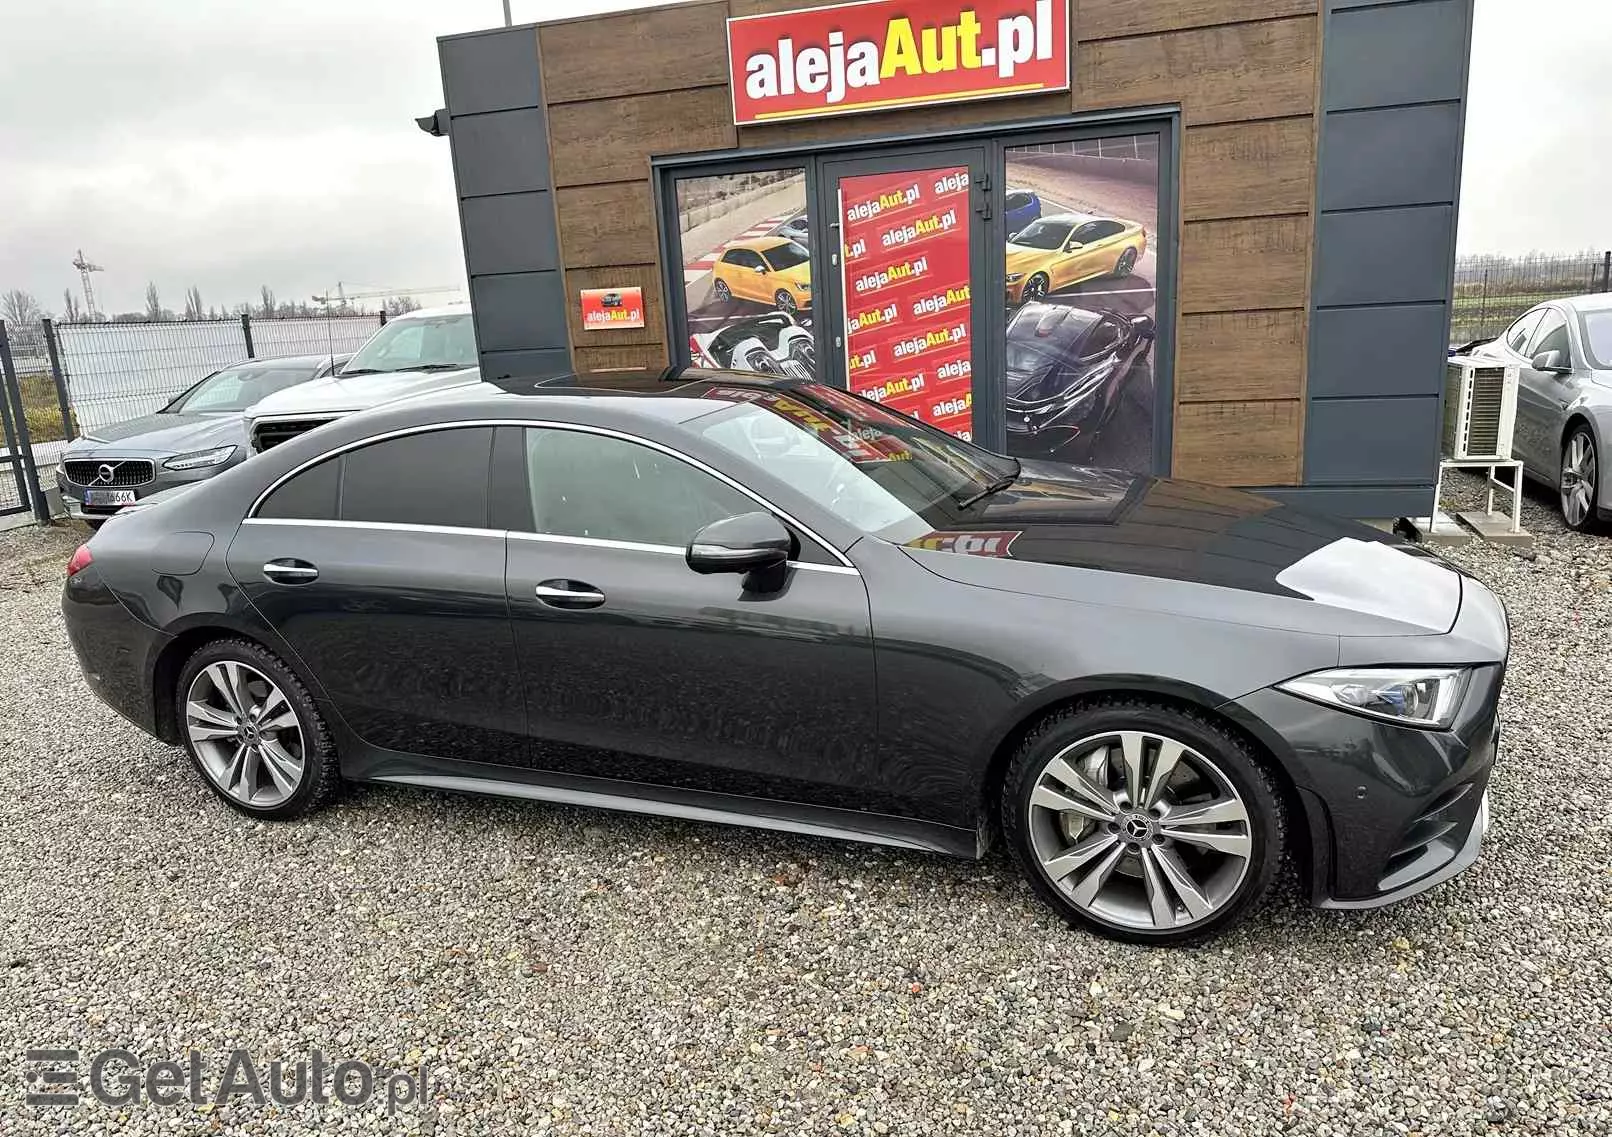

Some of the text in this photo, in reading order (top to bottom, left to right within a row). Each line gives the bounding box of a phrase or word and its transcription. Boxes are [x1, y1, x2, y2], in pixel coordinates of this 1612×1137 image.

[745, 0, 1053, 104] alejaAut.pl
[934, 172, 969, 194] aleja
[847, 183, 921, 221] alejaAut.pl
[881, 208, 957, 247] alejaAut.pl
[855, 256, 928, 292] alejaAut.pl
[587, 308, 640, 322] alejaAut.pl
[894, 323, 966, 357] alejaAut.pl
[937, 359, 971, 379] aleja
